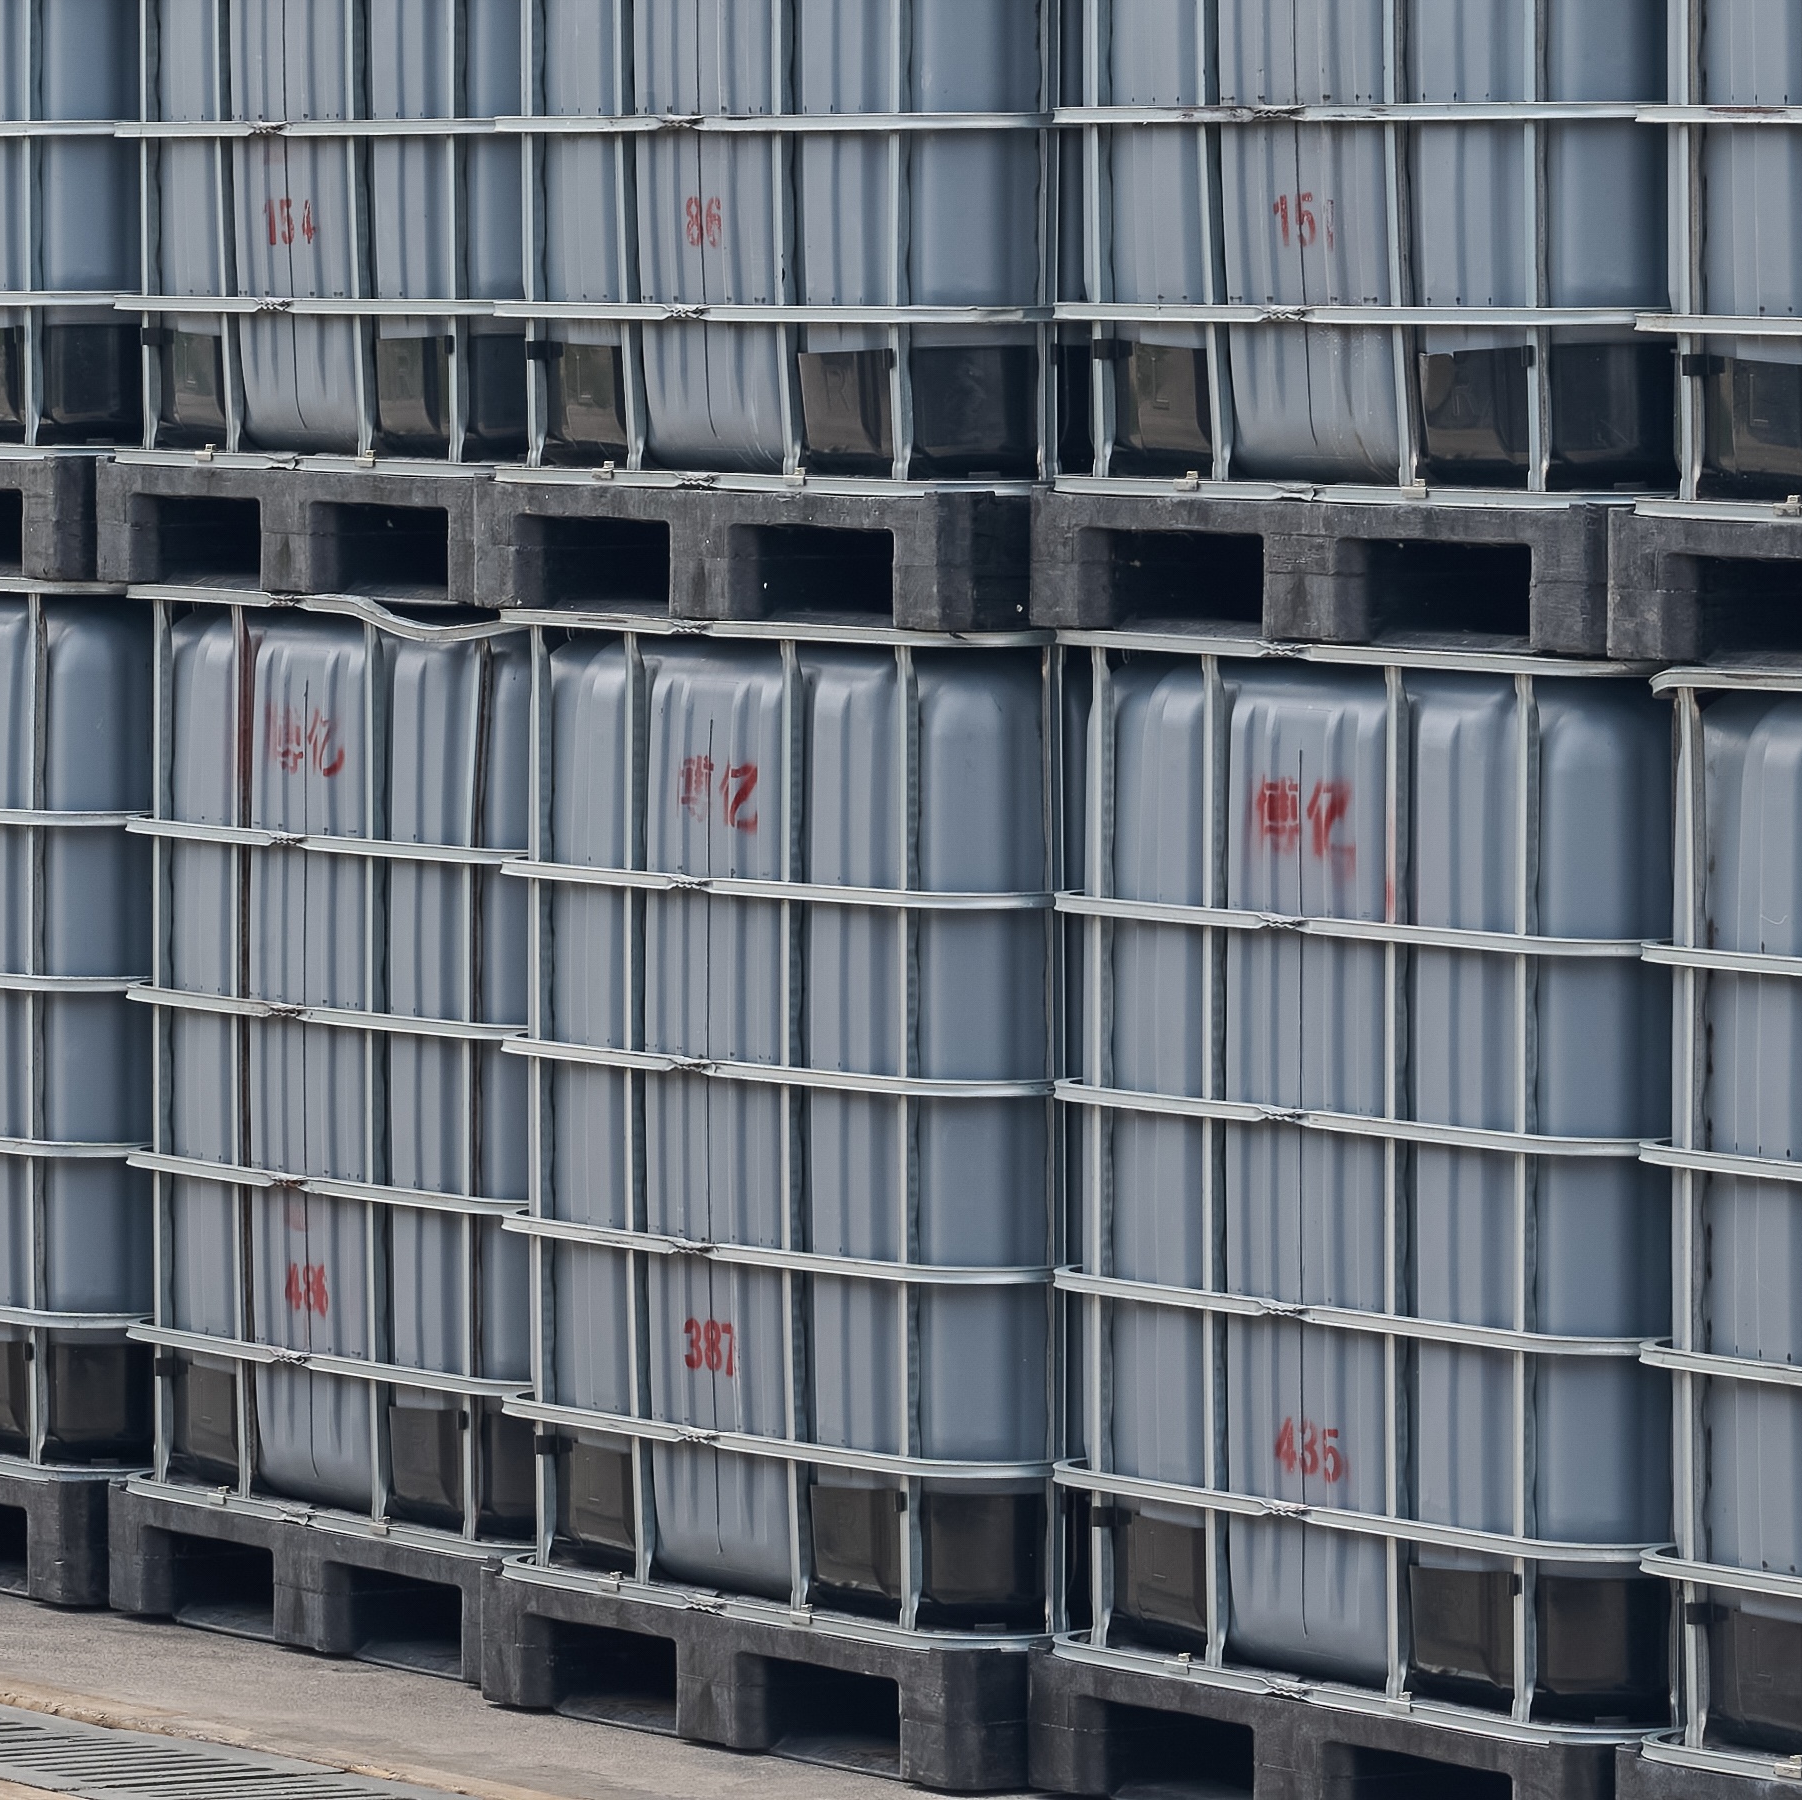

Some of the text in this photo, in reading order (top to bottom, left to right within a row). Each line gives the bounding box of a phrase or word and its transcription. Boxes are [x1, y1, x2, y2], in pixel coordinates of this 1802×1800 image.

[266, 198, 316, 245] 154
[686, 196, 722, 247] 86
[684, 1318, 735, 1377] 387
[1275, 1417, 1348, 1484] 435
